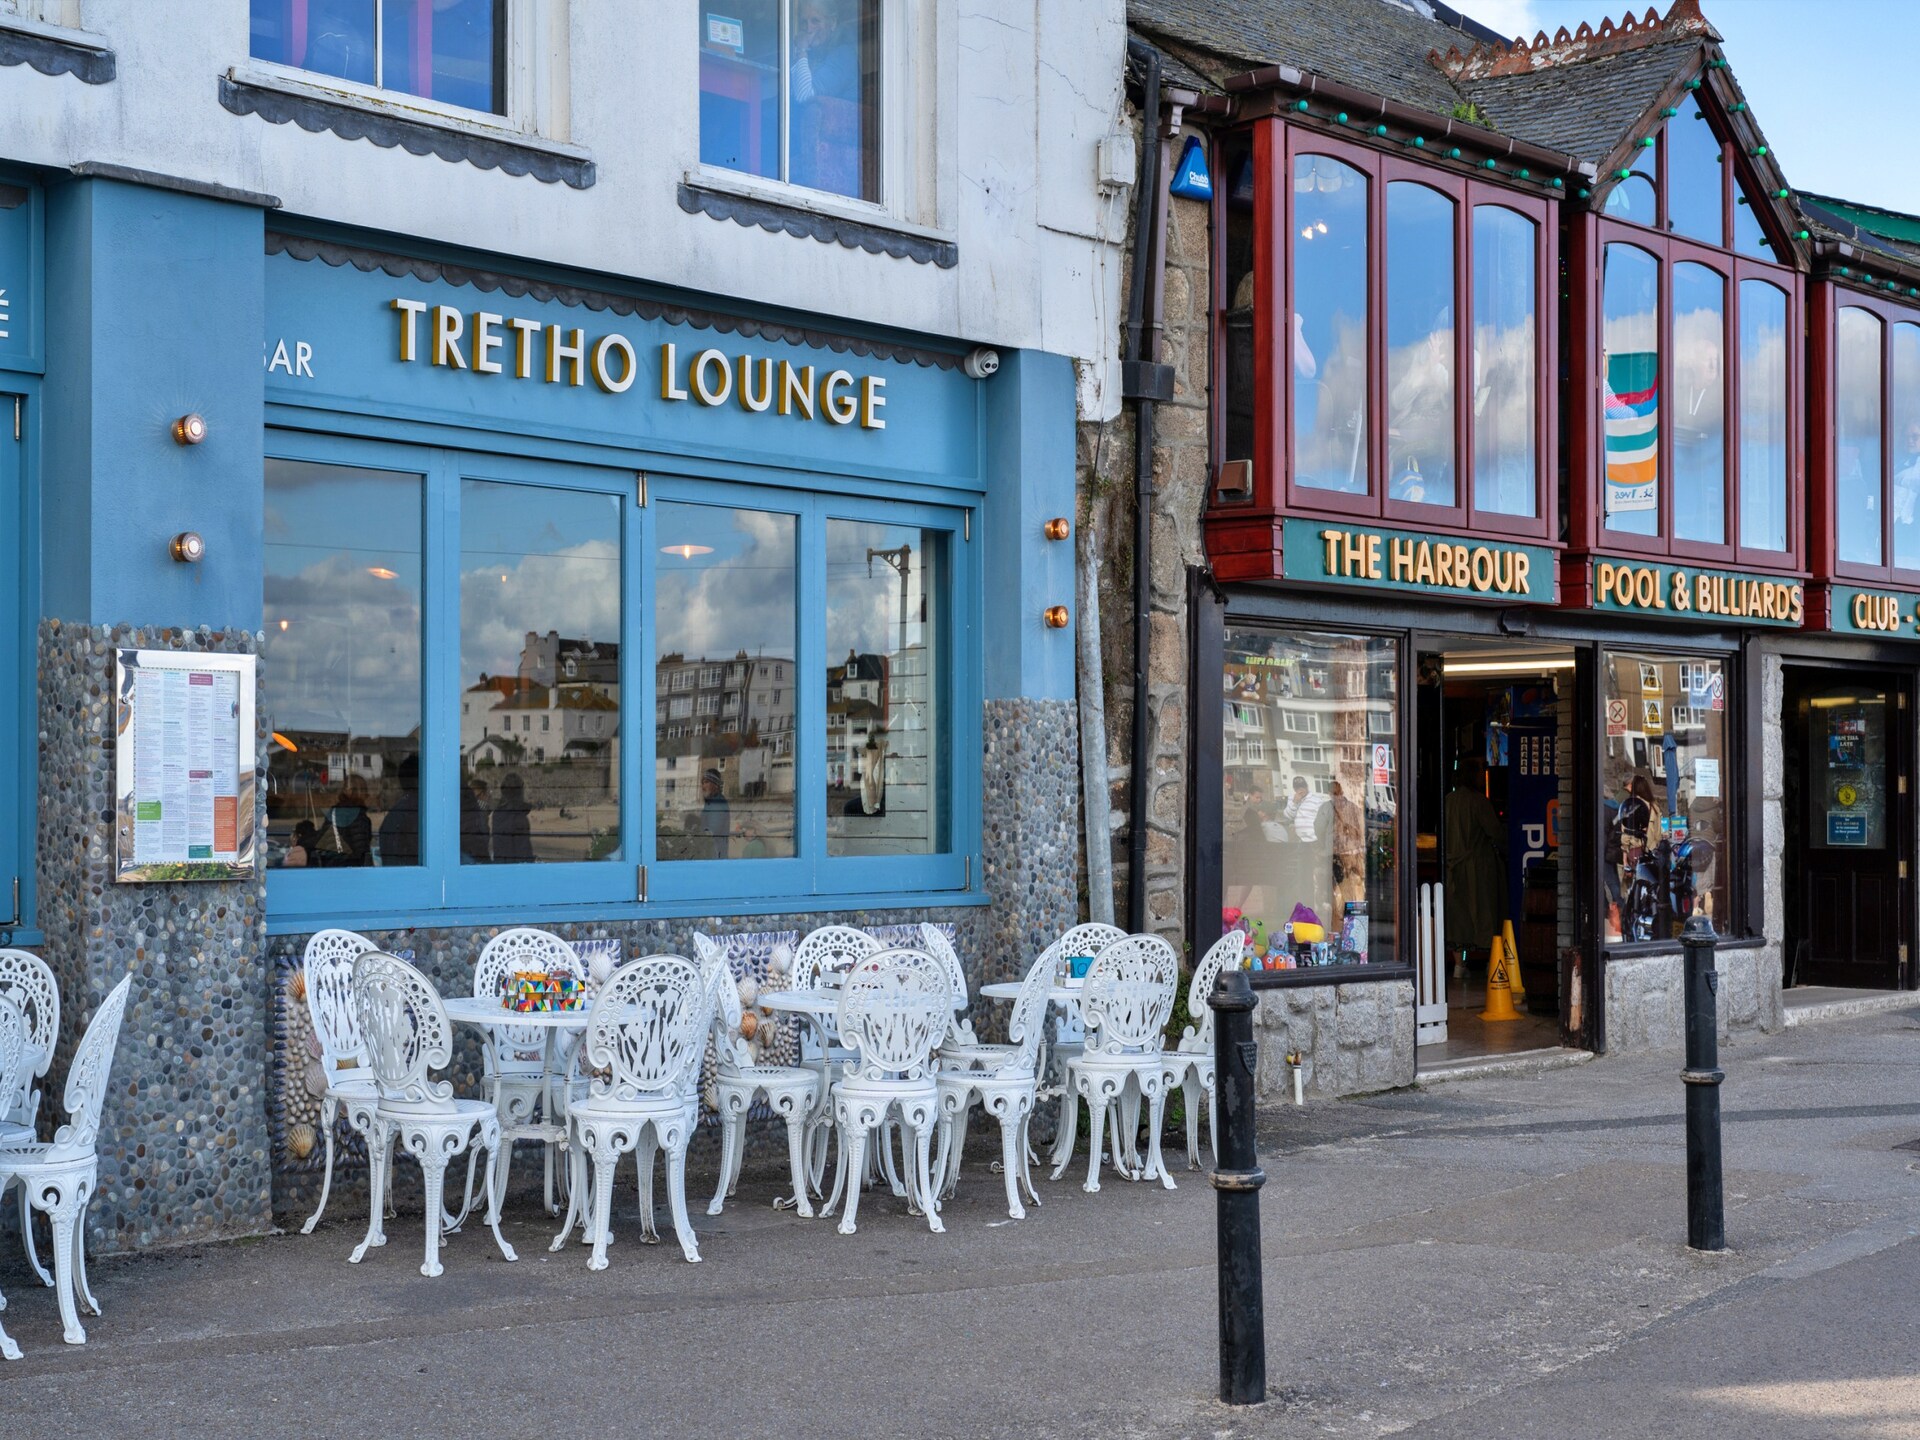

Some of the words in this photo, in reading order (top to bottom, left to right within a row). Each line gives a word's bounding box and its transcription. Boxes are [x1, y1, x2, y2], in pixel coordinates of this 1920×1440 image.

[1189, 171, 1209, 183] Chubb
[263, 338, 314, 378] AR
[390, 298, 637, 393] TRETHO
[661, 343, 886, 429] LOUNGE
[1321, 530, 1382, 579] THE
[1390, 537, 1530, 594] HARBOUR
[1597, 562, 1666, 609] POOL
[1672, 571, 1690, 611] &
[1696, 574, 1801, 622] BILLIARDS
[1852, 593, 1899, 631] CLUB
